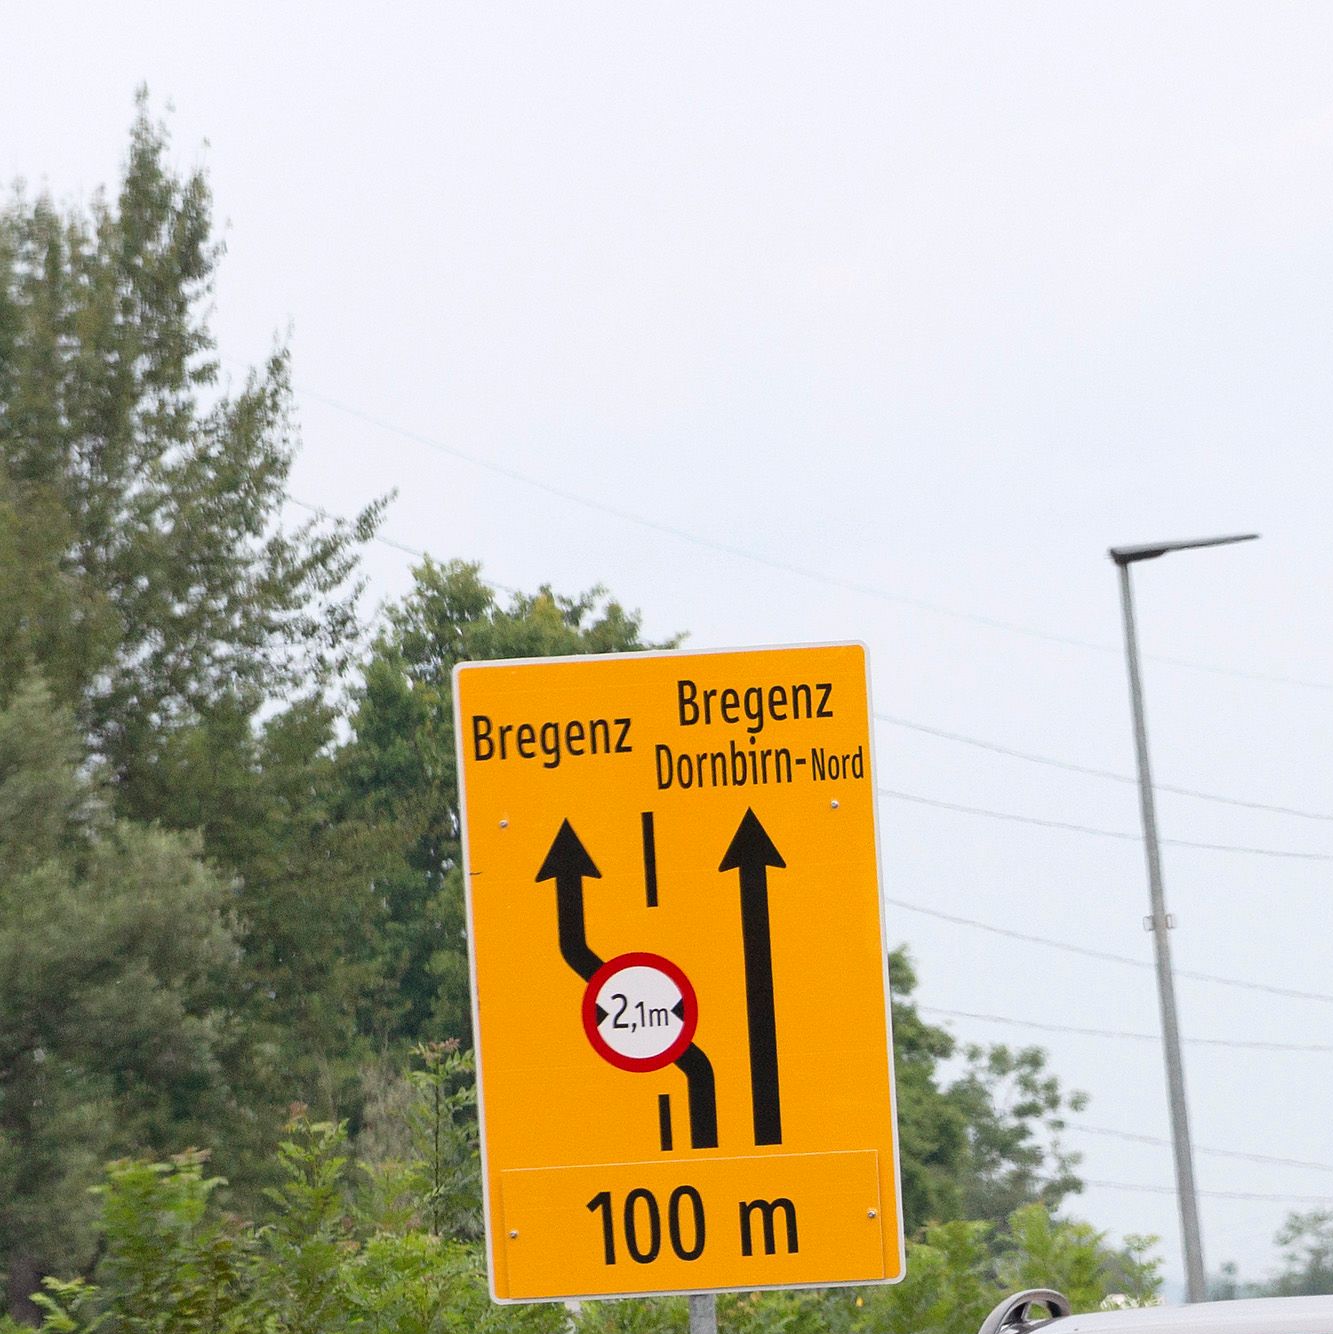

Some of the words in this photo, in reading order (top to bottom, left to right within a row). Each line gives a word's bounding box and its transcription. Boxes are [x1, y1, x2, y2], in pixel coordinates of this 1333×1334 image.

[677, 680, 833, 733] Bregenz
[472, 715, 633, 769] Bregenz
[610, 993, 669, 1033] 2,1m
[586, 1185, 705, 1265] 100
[738, 1198, 799, 1256] m
